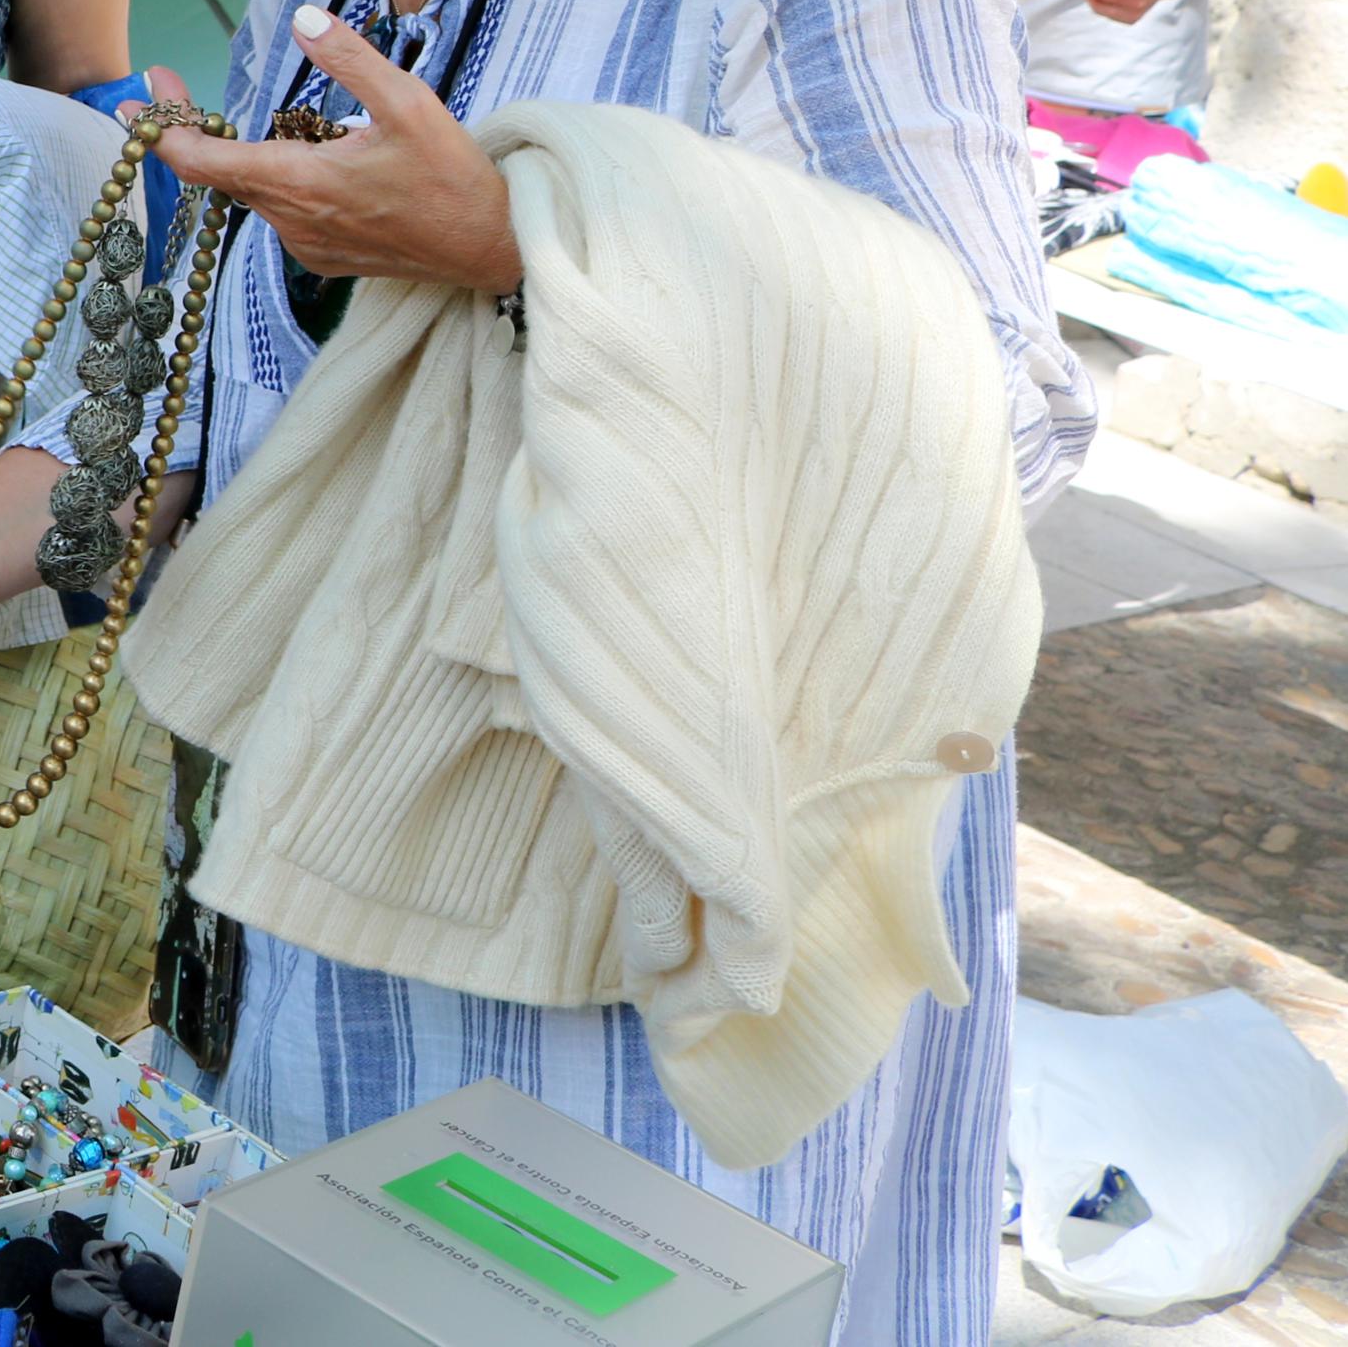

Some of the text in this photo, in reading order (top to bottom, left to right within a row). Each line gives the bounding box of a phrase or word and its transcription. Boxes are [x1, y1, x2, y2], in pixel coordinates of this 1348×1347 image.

[439, 1119, 495, 1154] Cáncer
[497, 1153, 516, 1165] el
[516, 1161, 572, 1196] Contra
[315, 1172, 617, 1347] Asociación Española Contra el Cánce
[655, 1238, 748, 1292] Asociación
